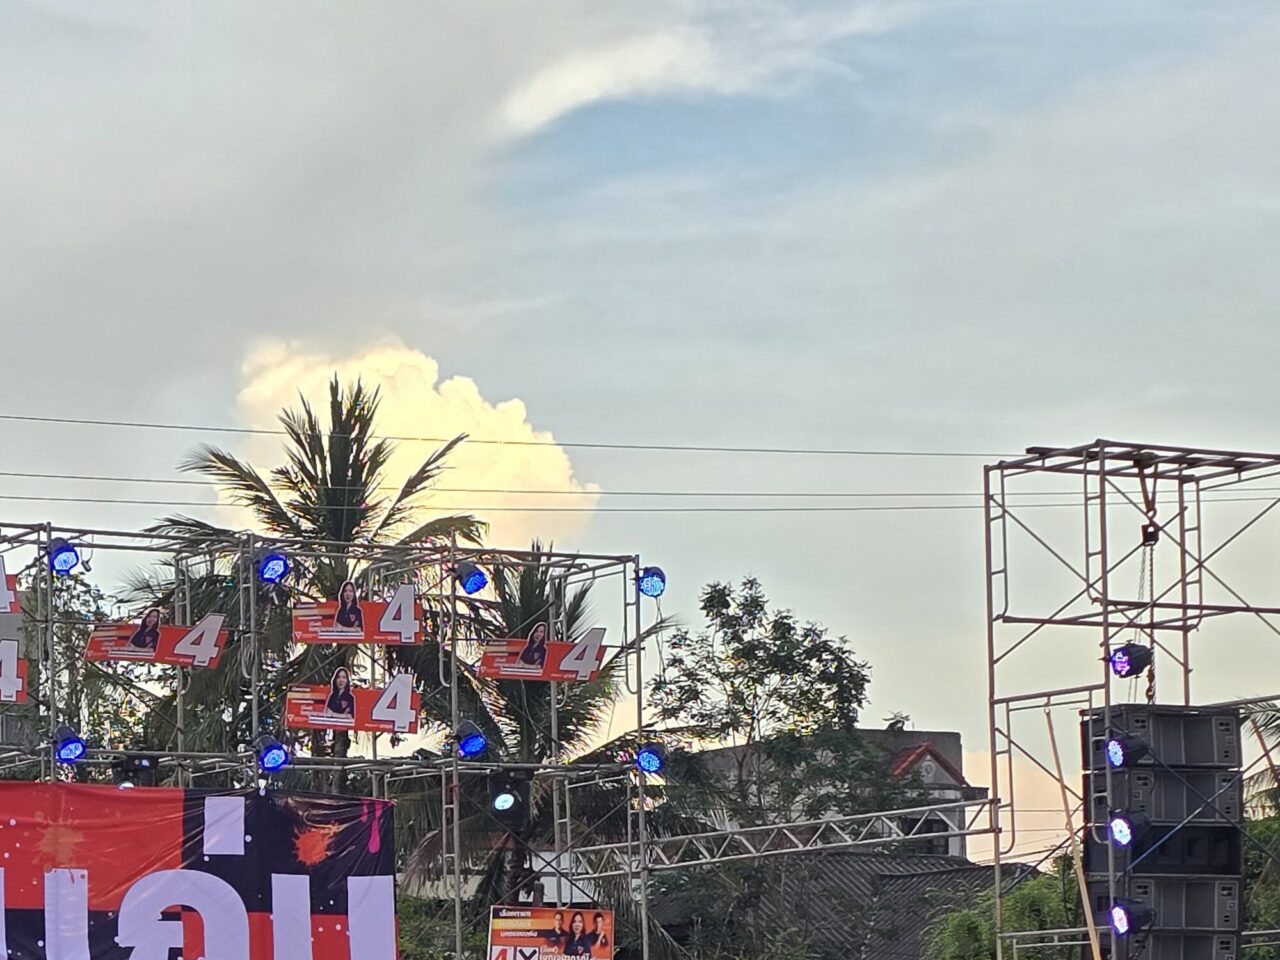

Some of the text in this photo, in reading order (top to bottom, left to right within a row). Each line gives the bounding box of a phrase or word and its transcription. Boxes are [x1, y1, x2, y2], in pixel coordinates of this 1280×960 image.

[174, 613, 225, 666] 4
[379, 584, 420, 643] 4
[559, 628, 606, 680] 4
[372, 673, 416, 732] 4
